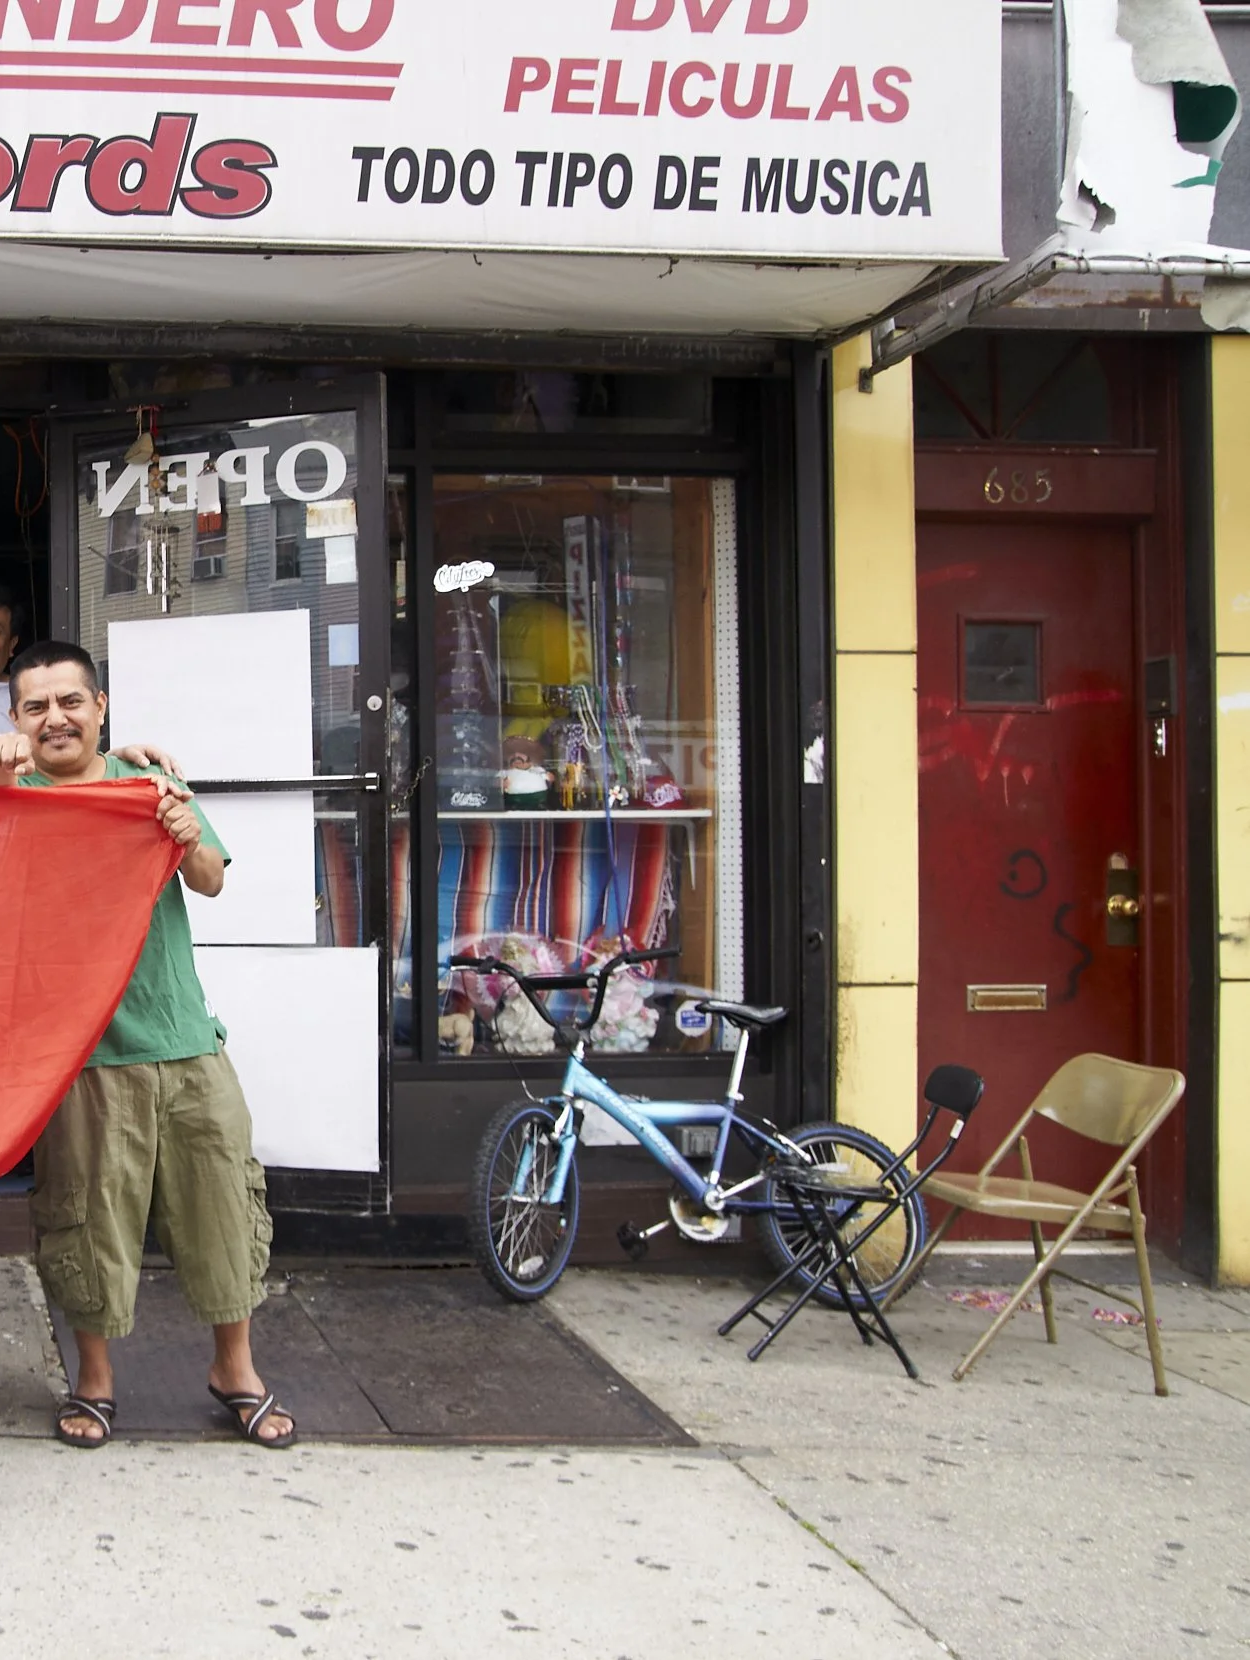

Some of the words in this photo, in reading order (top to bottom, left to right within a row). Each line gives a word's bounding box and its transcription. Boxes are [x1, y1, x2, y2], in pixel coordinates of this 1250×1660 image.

[503, 56, 912, 124] PELICULAS
[352, 146, 495, 206] TODO
[515, 150, 633, 210] TIPO
[653, 154, 722, 212] DE
[741, 157, 931, 217] MUSICA
[984, 467, 1053, 504] 685
